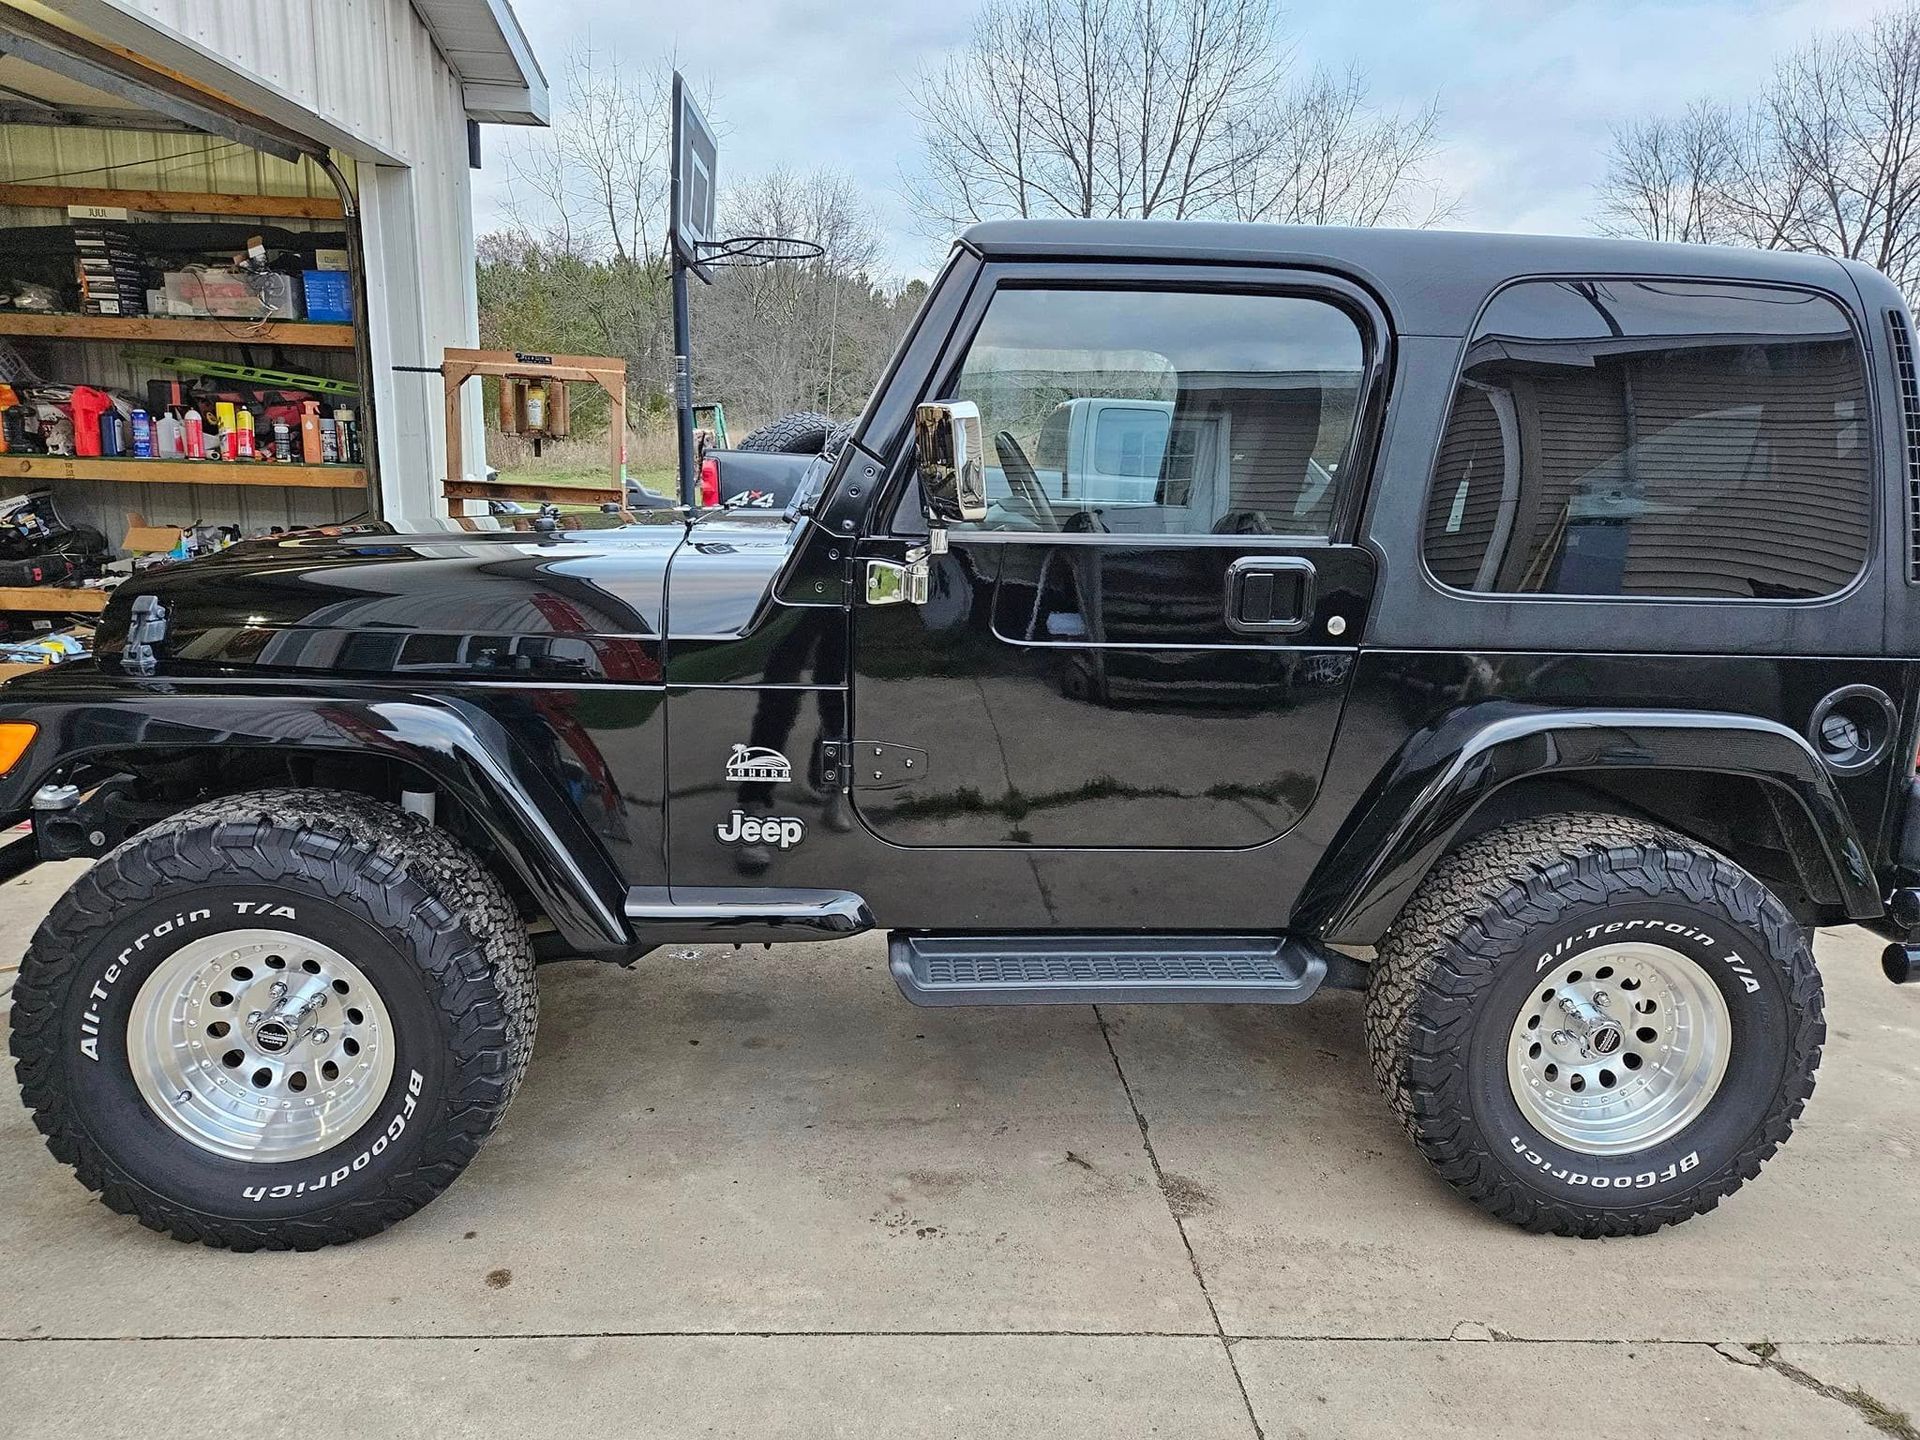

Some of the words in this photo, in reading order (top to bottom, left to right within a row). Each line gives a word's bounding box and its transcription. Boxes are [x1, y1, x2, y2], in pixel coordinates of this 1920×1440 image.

[727, 767, 790, 778] SAHARA
[717, 809, 804, 848] Jeep
[80, 908, 211, 1062] All-Terrain
[233, 902, 296, 920] T/A
[1535, 919, 1716, 973] All-Terrain
[1723, 950, 1761, 994] T/A
[242, 1069, 424, 1202] BFGoodrich
[1510, 1135, 1701, 1189] BFGoodrich
